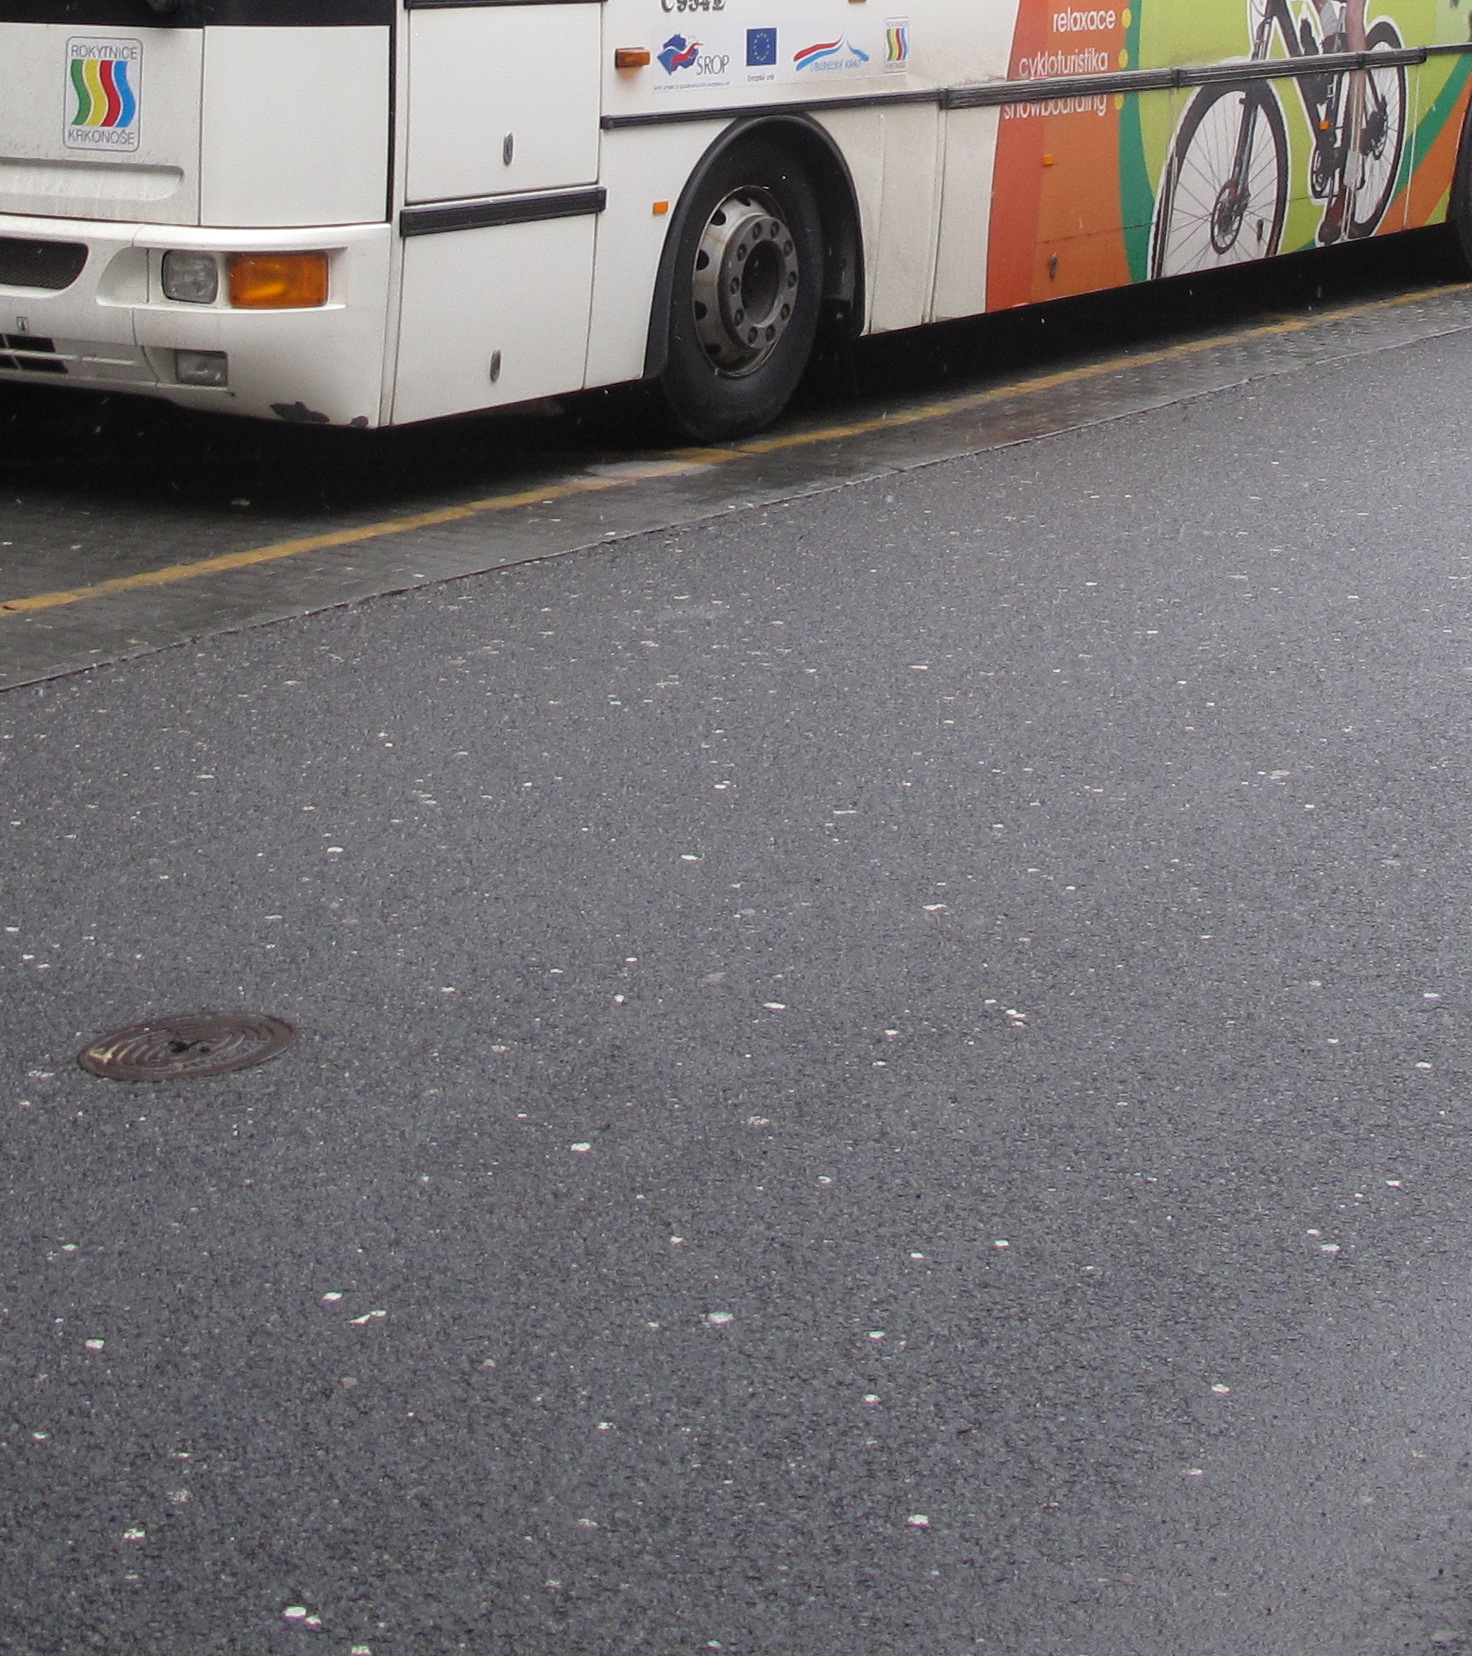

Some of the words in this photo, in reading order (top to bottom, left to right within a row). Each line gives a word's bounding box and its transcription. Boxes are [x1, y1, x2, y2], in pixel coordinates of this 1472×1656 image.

[1053, 7, 1116, 32] relaxace
[71, 44, 138, 59] ROKYTNICE
[696, 55, 730, 76] SROP
[1018, 48, 1109, 80] cykloturistika
[68, 129, 135, 145] KRKONOŠE
